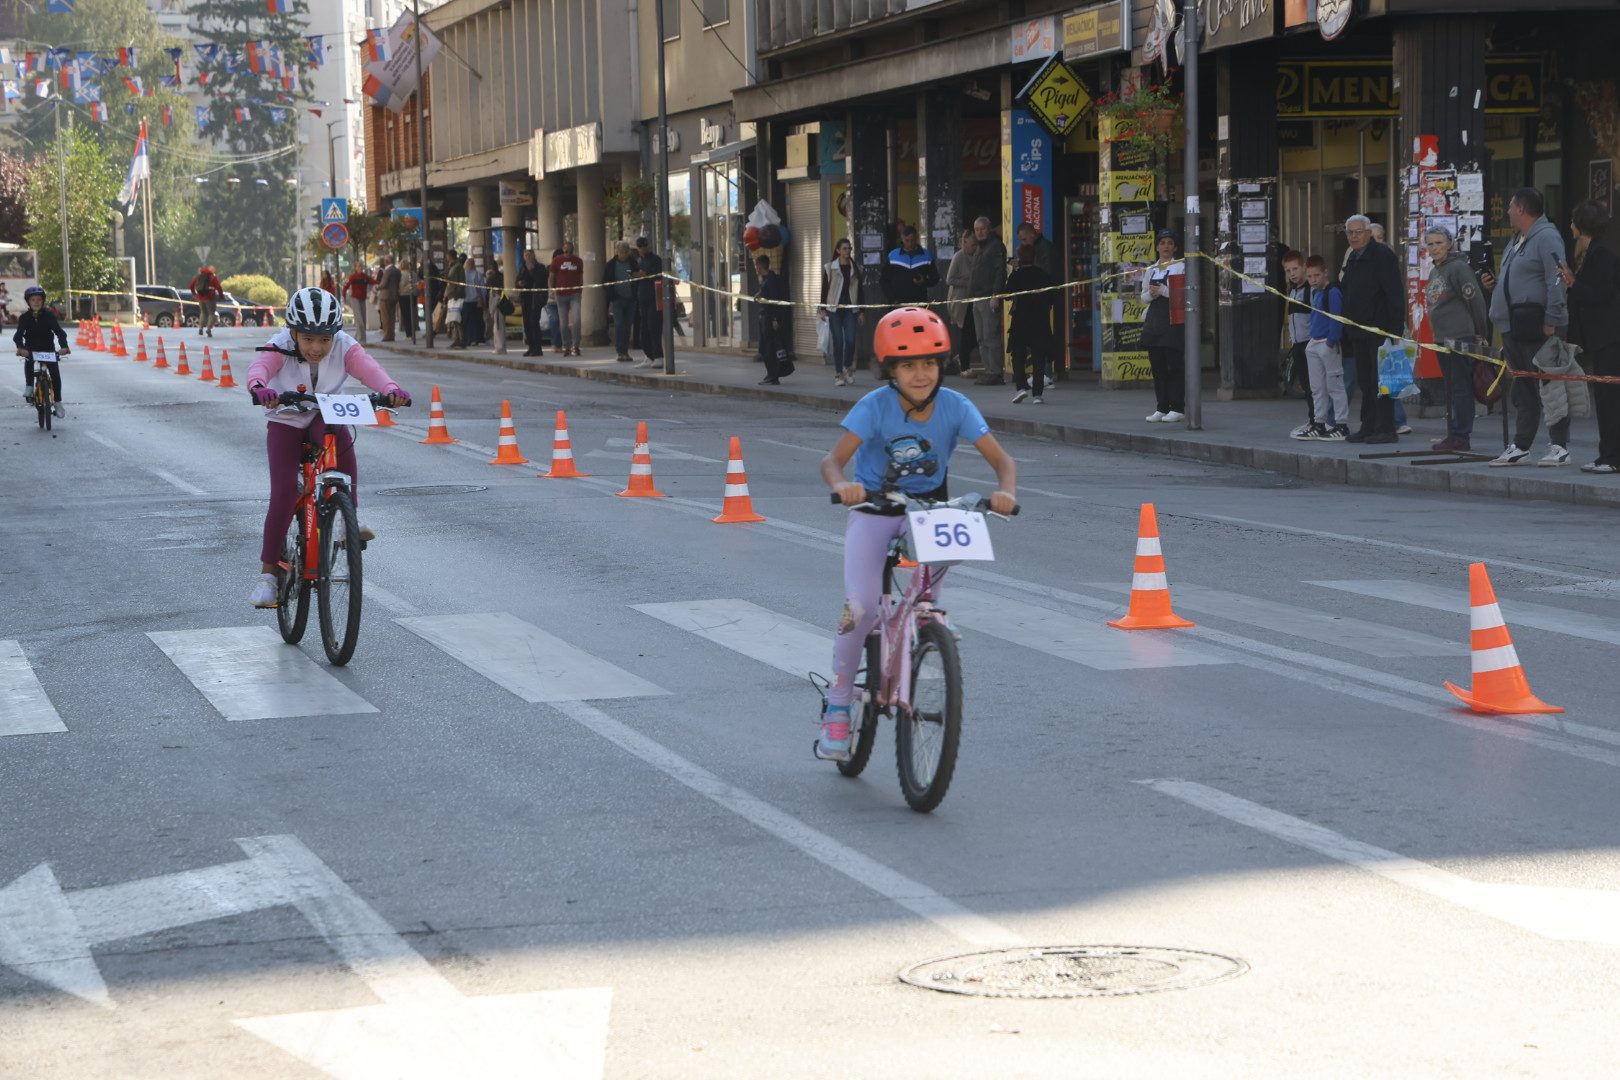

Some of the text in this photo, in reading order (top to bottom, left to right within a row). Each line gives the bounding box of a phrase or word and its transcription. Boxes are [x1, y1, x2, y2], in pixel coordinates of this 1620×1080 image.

[1041, 87, 1080, 109] Pigal
[1031, 138, 1042, 161] IPS
[1116, 241, 1152, 262] Pigal
[332, 403, 360, 417] 99
[934, 523, 971, 547] 56
